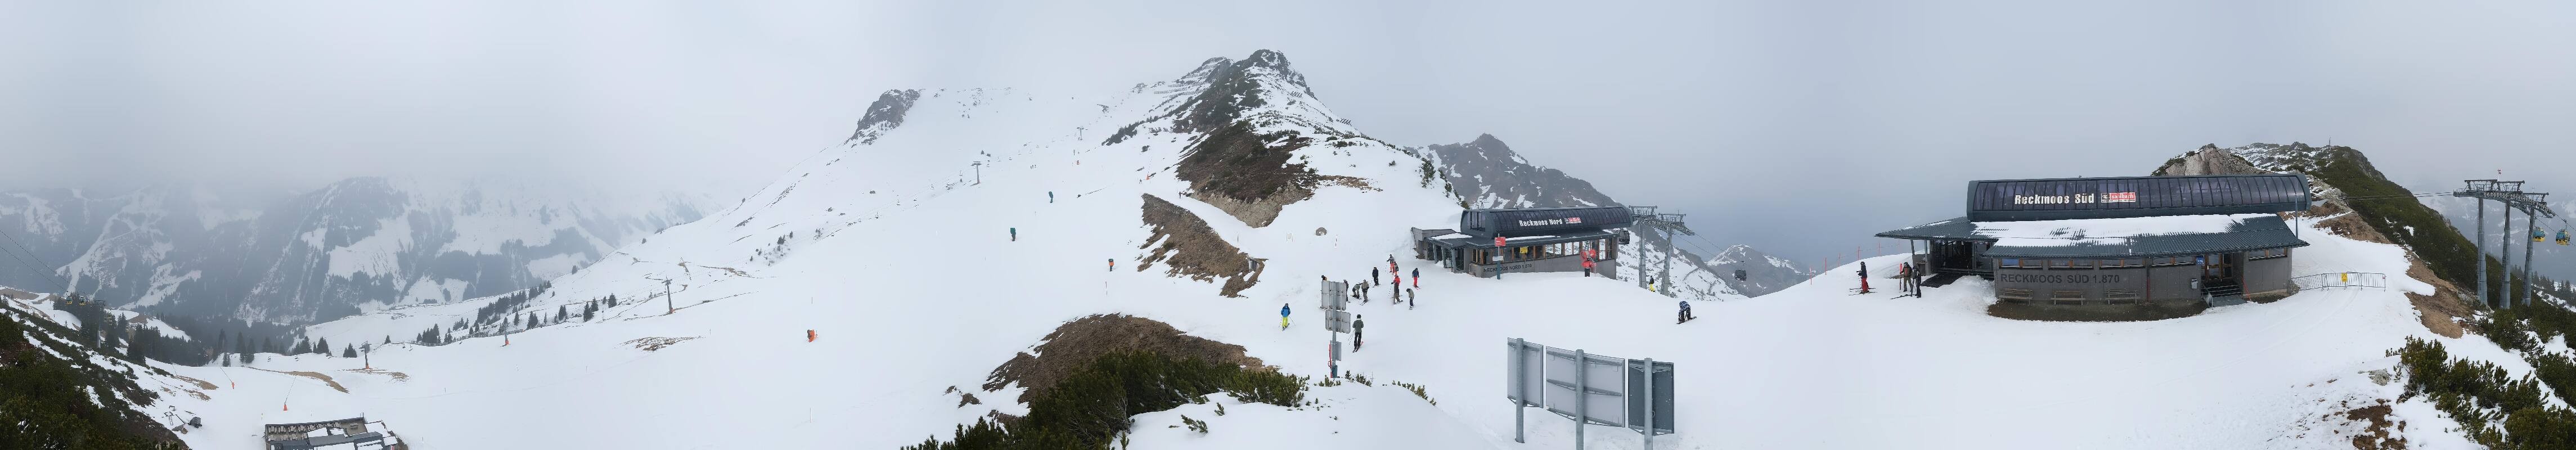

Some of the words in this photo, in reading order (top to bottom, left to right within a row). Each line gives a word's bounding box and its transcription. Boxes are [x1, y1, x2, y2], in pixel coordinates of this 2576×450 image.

[2015, 194, 2070, 205] Reckmoos
[2074, 193, 2094, 204] Süd
[2000, 273, 2062, 284] RECKMOOS
[2067, 273, 2089, 284] SÜD
[2092, 274, 2120, 284] 1.870
